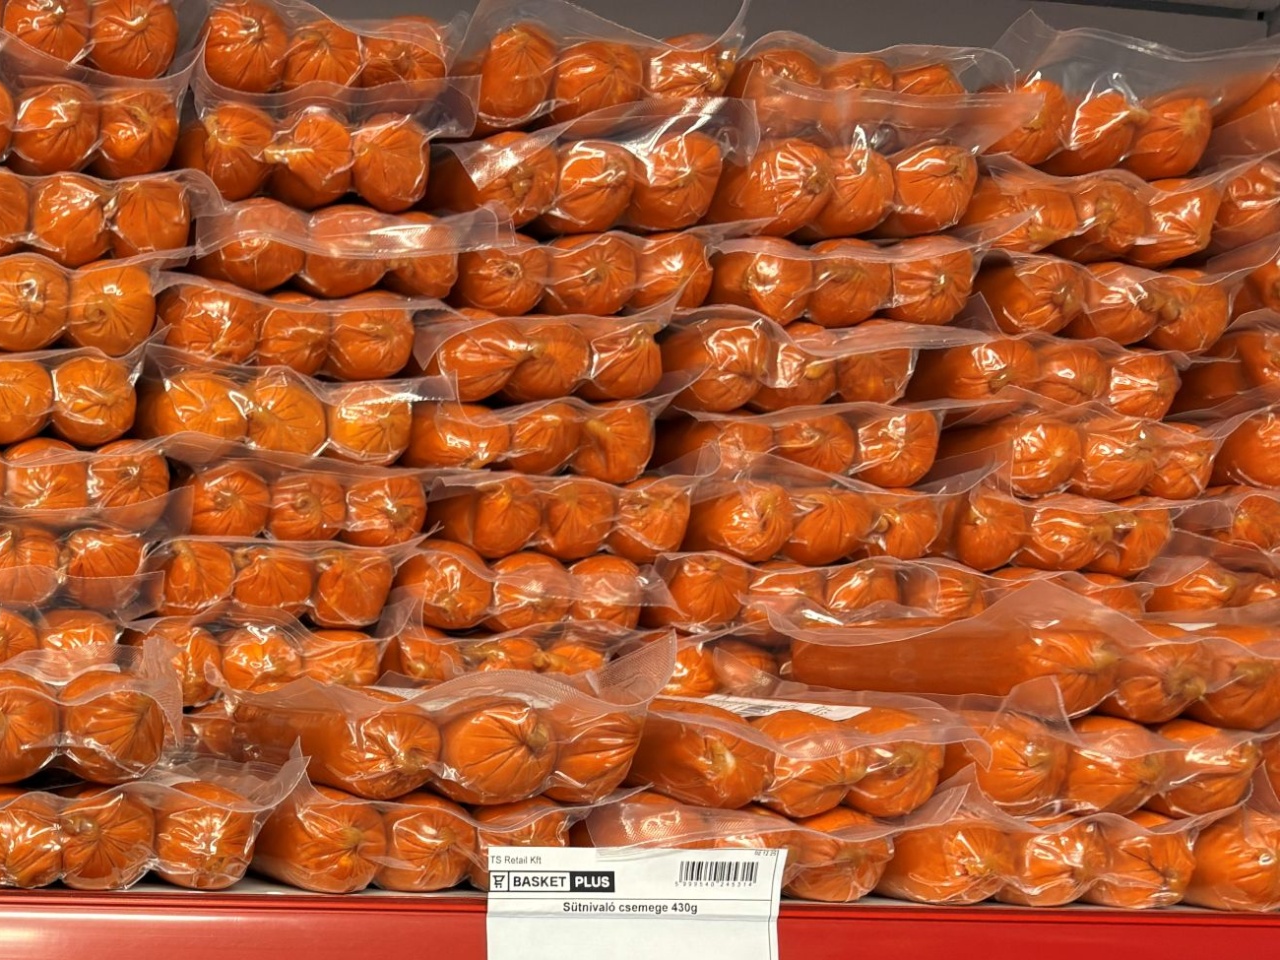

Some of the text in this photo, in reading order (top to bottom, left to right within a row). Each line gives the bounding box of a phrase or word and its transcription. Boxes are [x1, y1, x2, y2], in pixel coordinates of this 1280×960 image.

[491, 856, 542, 864] TS Retail Kft
[513, 876, 610, 888] BASKET PLUS
[563, 901, 698, 915] Sütnivaló csemege 430g
